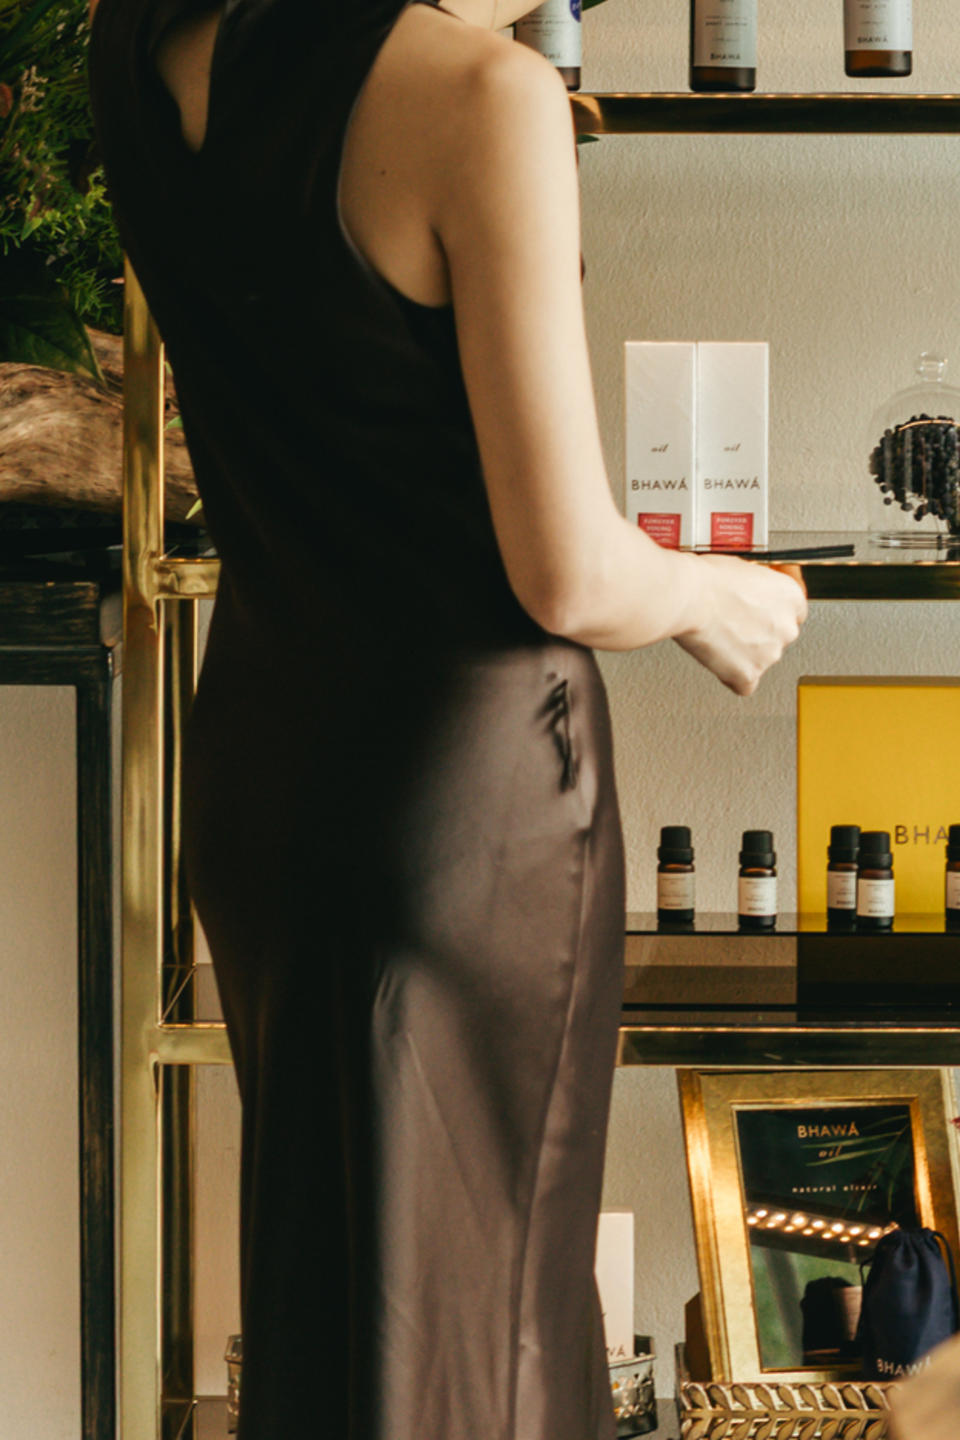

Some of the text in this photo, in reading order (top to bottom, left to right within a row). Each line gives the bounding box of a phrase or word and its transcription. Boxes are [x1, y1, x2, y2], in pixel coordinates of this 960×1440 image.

[631, 477, 688, 491] BHAWÁ
[703, 476, 761, 490] BHAWÁ
[796, 1121, 860, 1138] BHAWÁ
